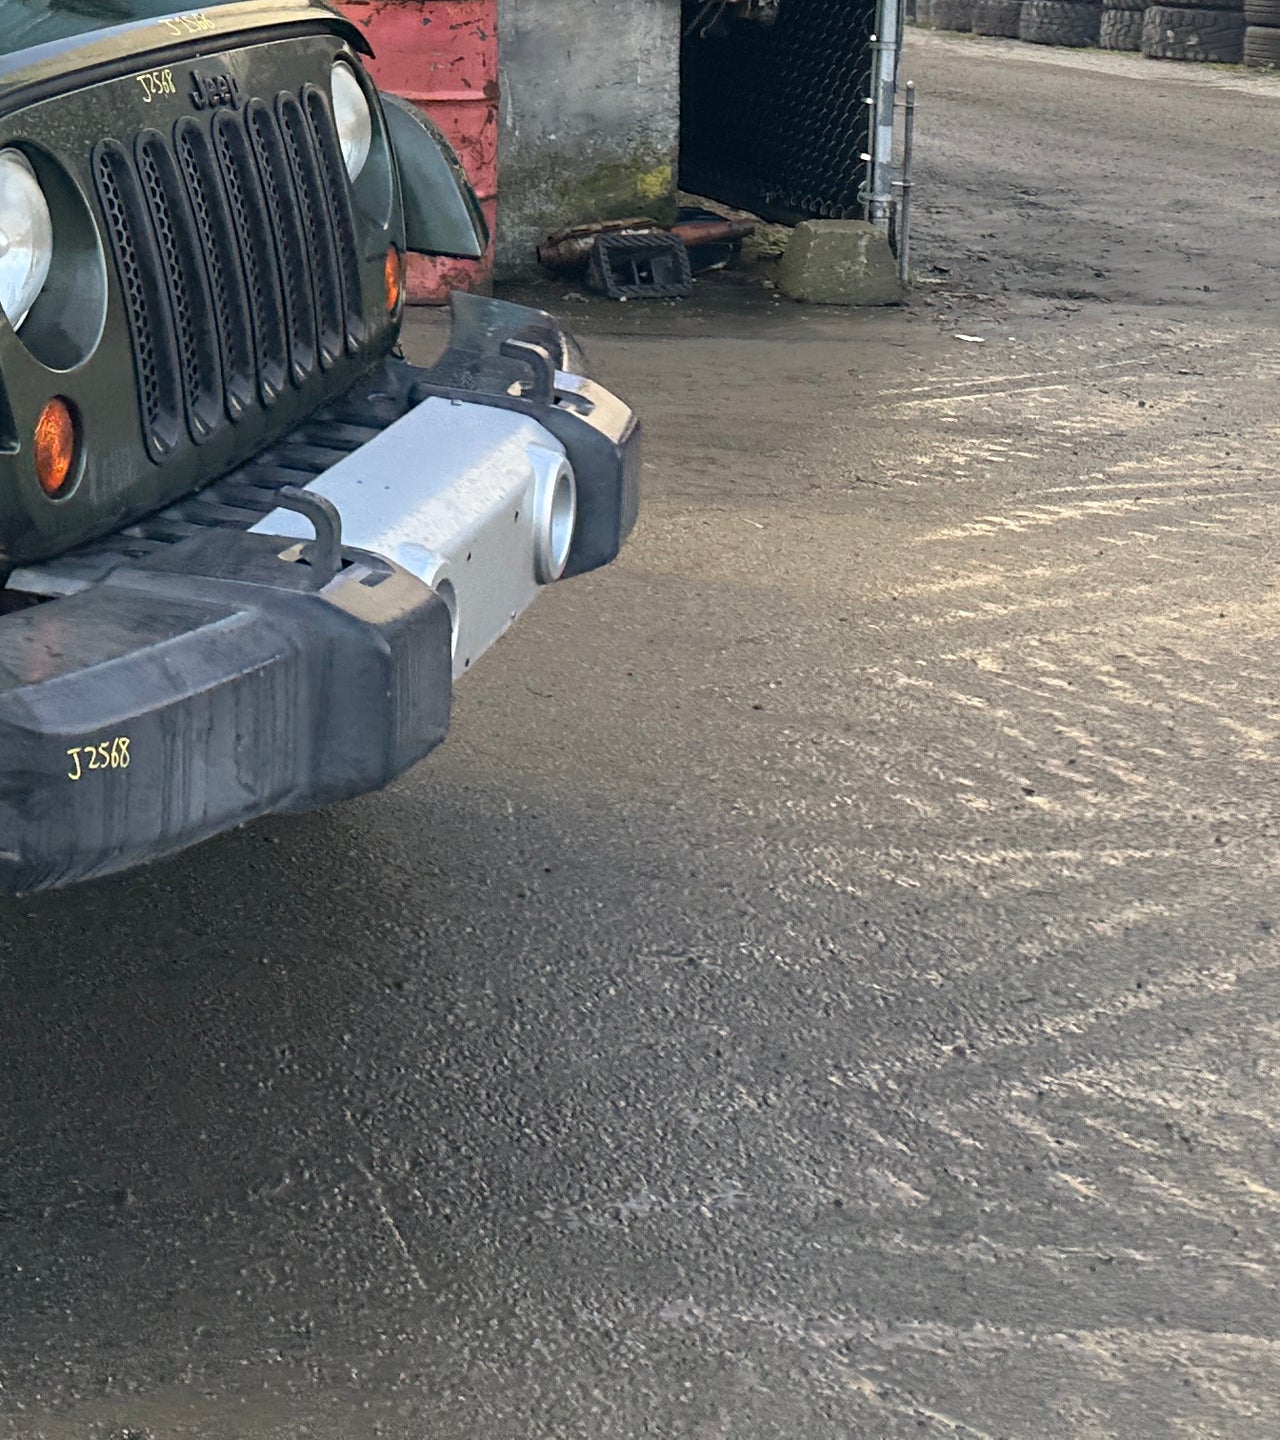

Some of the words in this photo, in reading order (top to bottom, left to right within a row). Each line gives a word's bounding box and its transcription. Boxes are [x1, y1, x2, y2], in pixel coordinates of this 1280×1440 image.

[136, 69, 176, 103] J2568
[189, 70, 240, 110] Jeep
[66, 736, 132, 780] J2568
